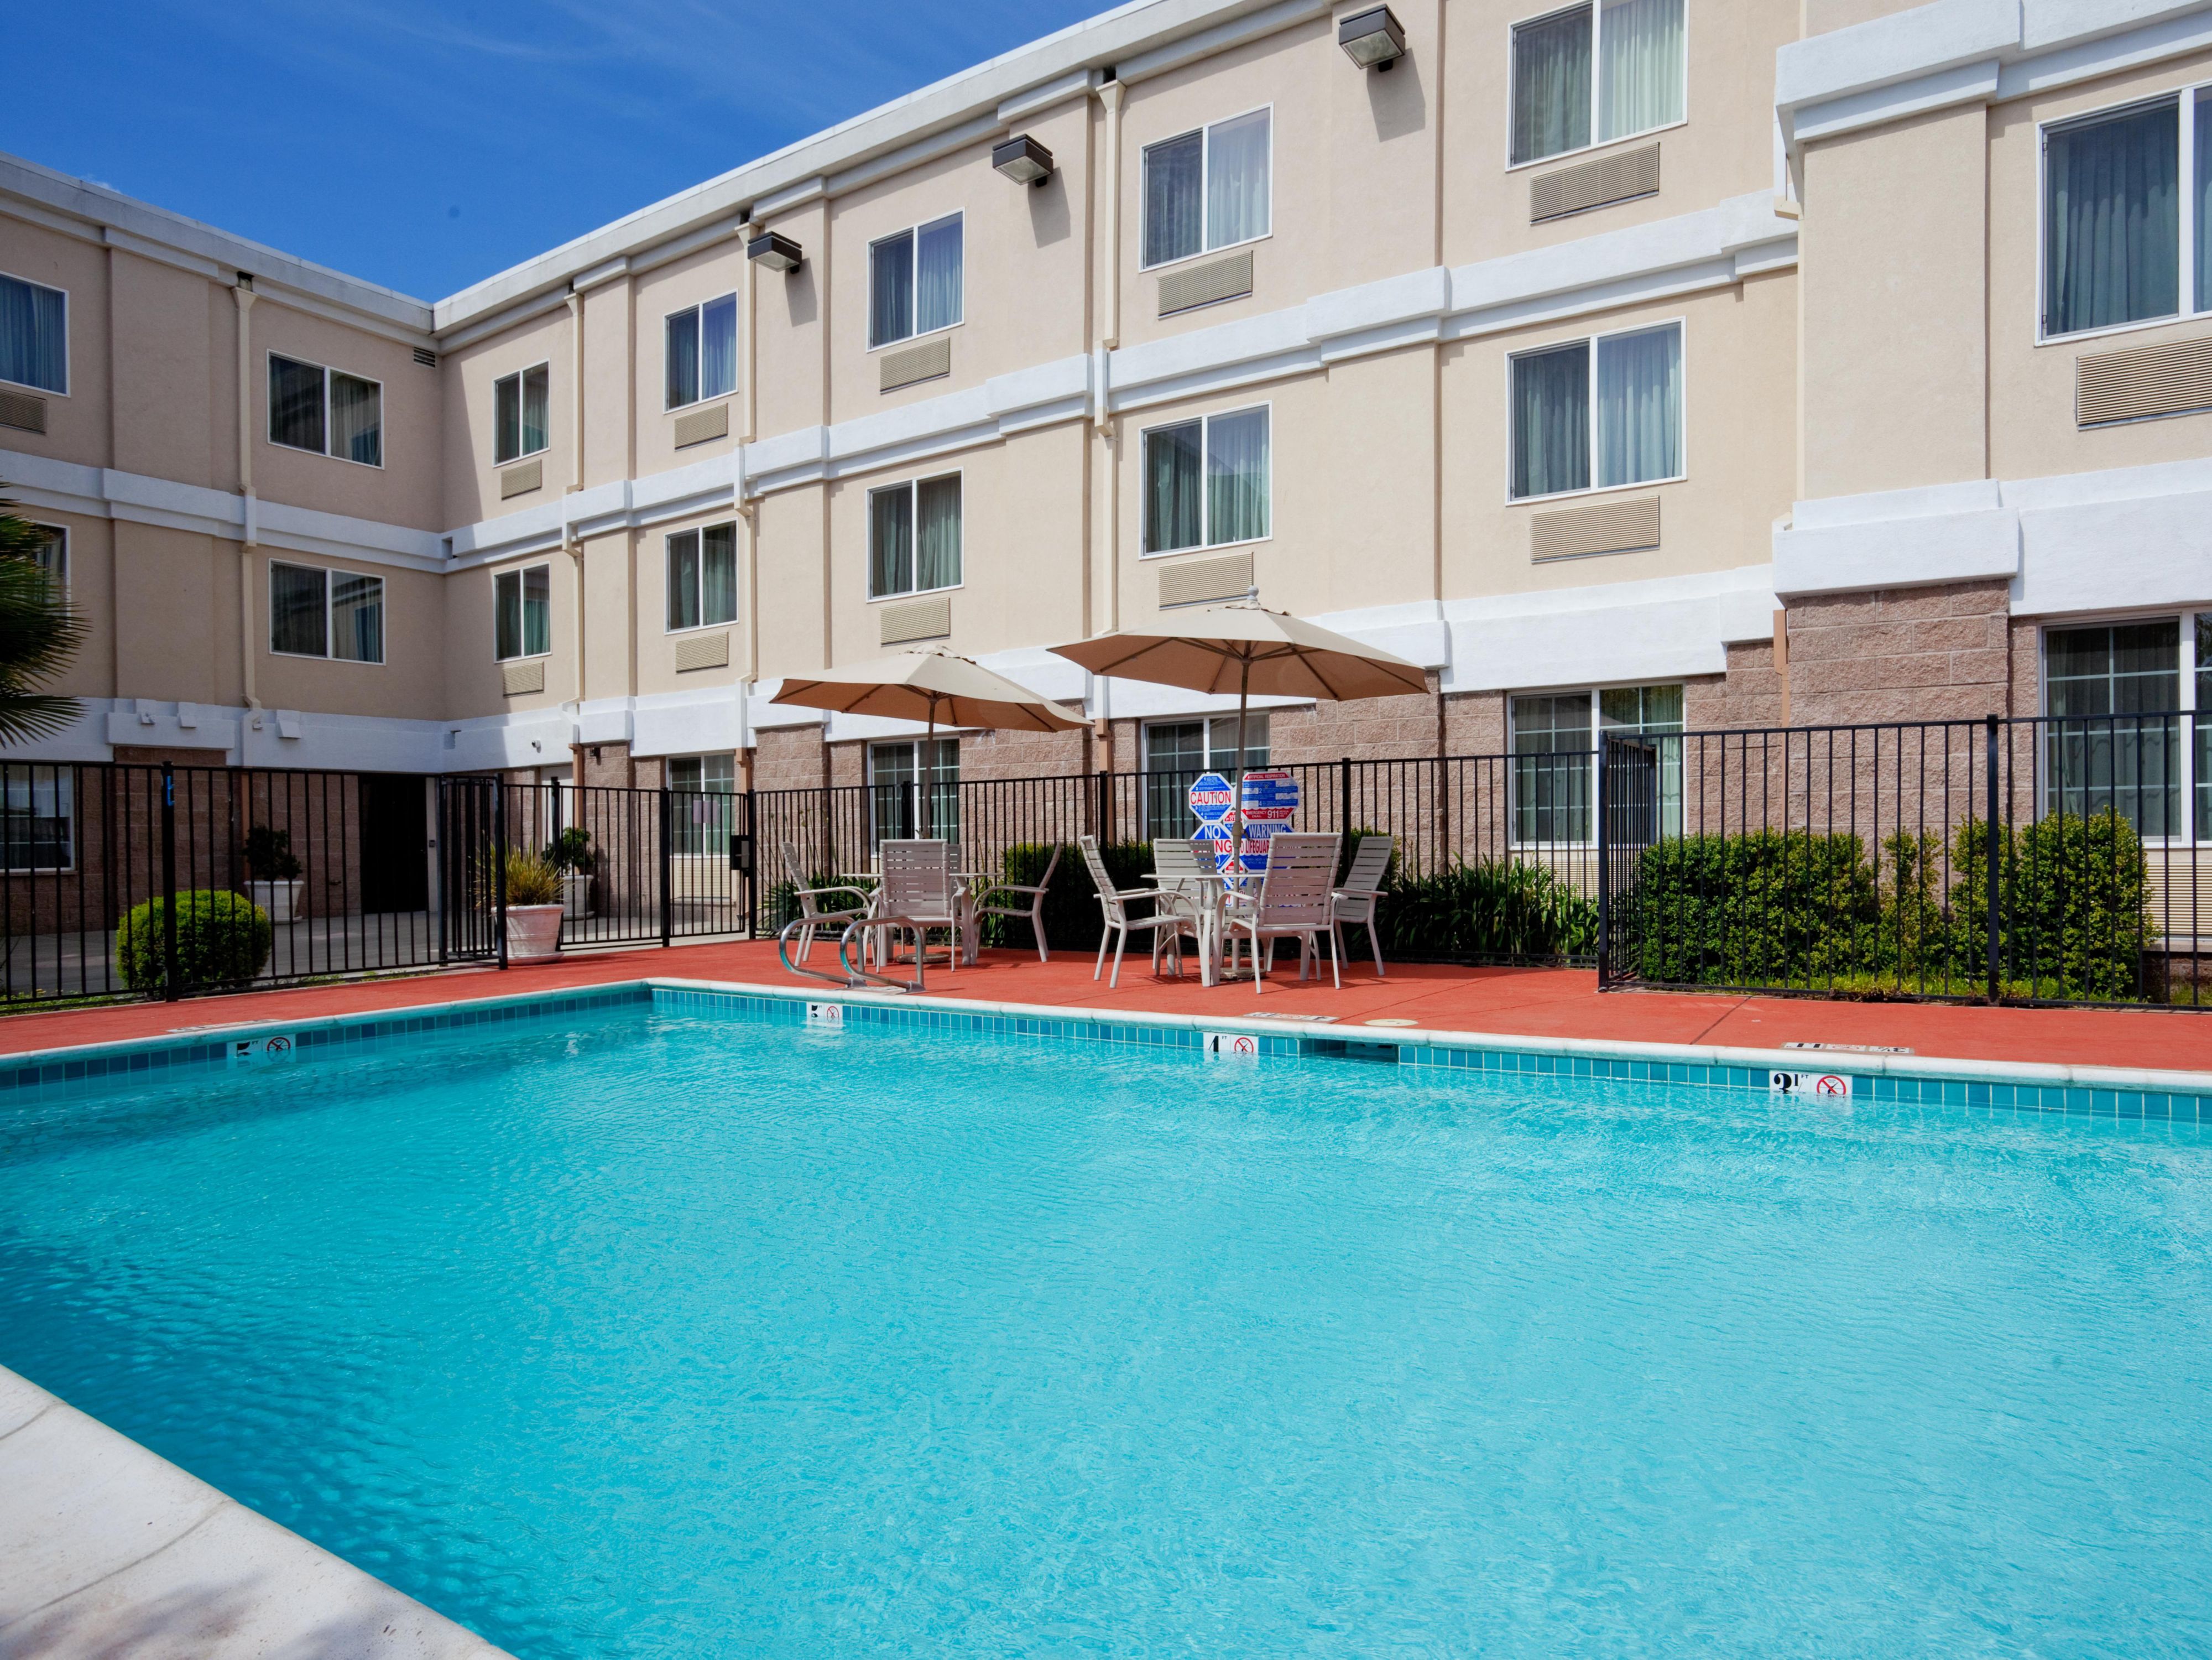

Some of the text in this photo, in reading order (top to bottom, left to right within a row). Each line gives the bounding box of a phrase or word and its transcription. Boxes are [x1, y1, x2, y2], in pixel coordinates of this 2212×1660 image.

[1190, 791, 1231, 804] CAUTION
[1267, 810, 1279, 819] 911
[1204, 825, 1221, 839] NO
[1249, 823, 1286, 839] WARNING
[1245, 840, 1270, 854] LIFEGUAR
